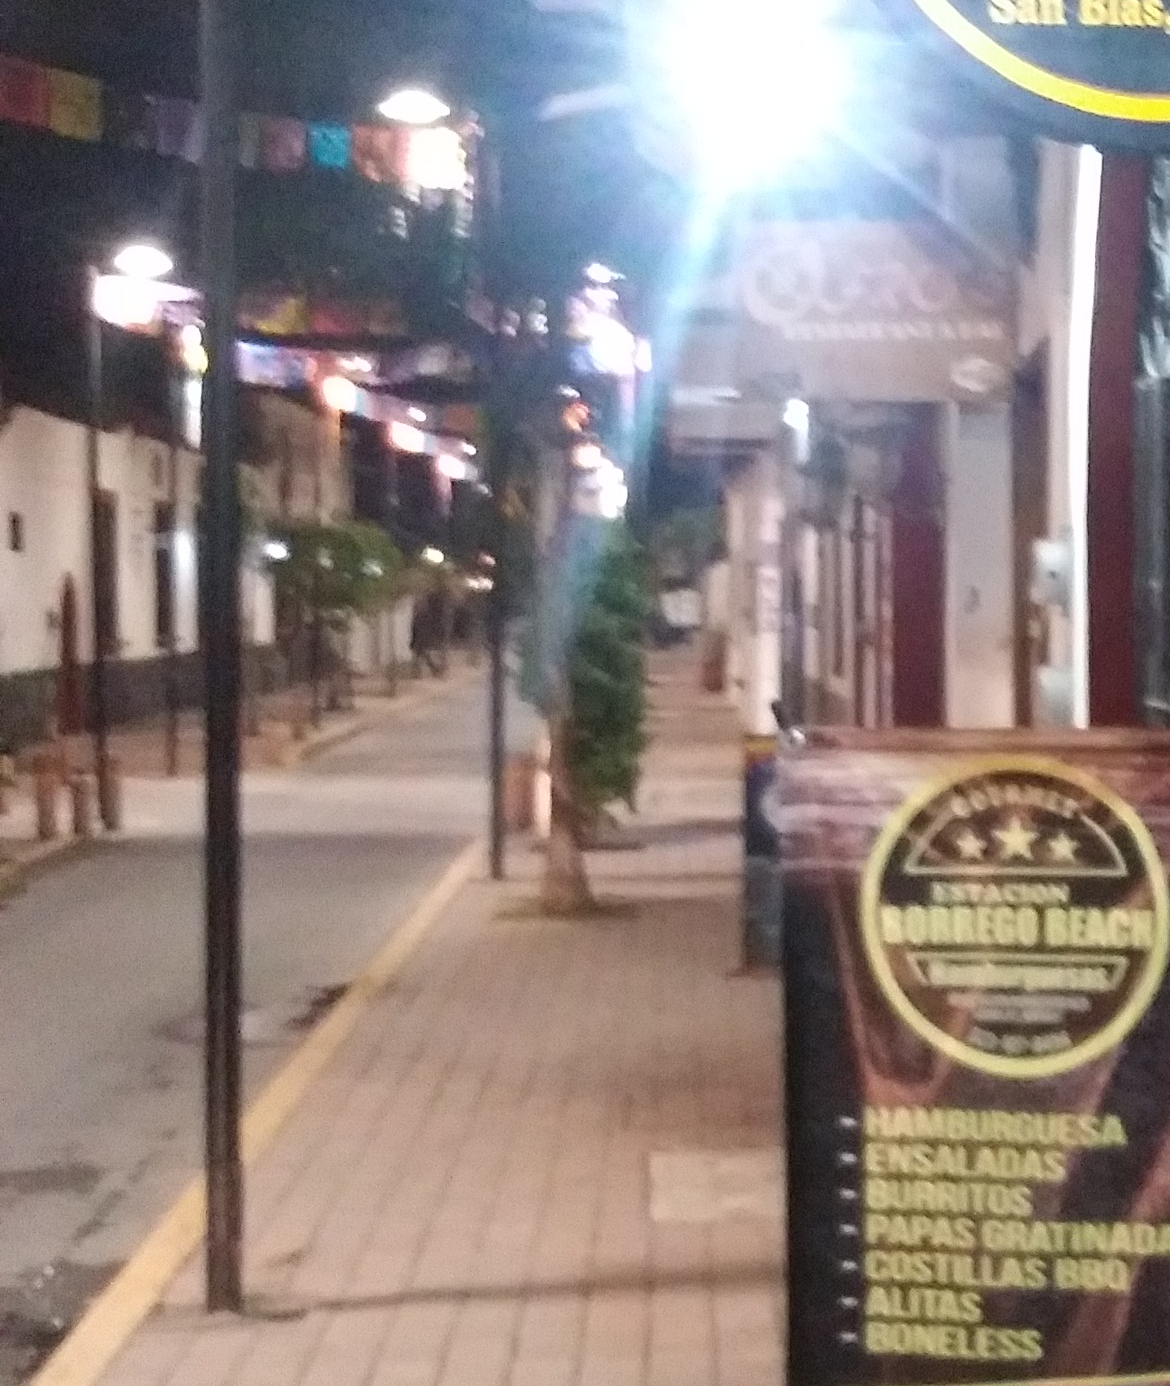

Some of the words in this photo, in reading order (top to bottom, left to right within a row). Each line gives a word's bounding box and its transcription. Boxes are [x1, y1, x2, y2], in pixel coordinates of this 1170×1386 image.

[933, 881, 1071, 905] ESTACION
[880, 905, 1036, 947] BORREGO
[1043, 907, 1152, 949] BEACH
[864, 1107, 1128, 1147] HAMBURGUESA
[864, 1143, 1066, 1183] ENSALADAS
[864, 1180, 1034, 1217] BURRITOS
[864, 1215, 978, 1249] PAPAS
[864, 1250, 1048, 1289] COSTILLAS
[864, 1287, 984, 1324] ALITAS
[864, 1321, 1044, 1361] BONELESS
